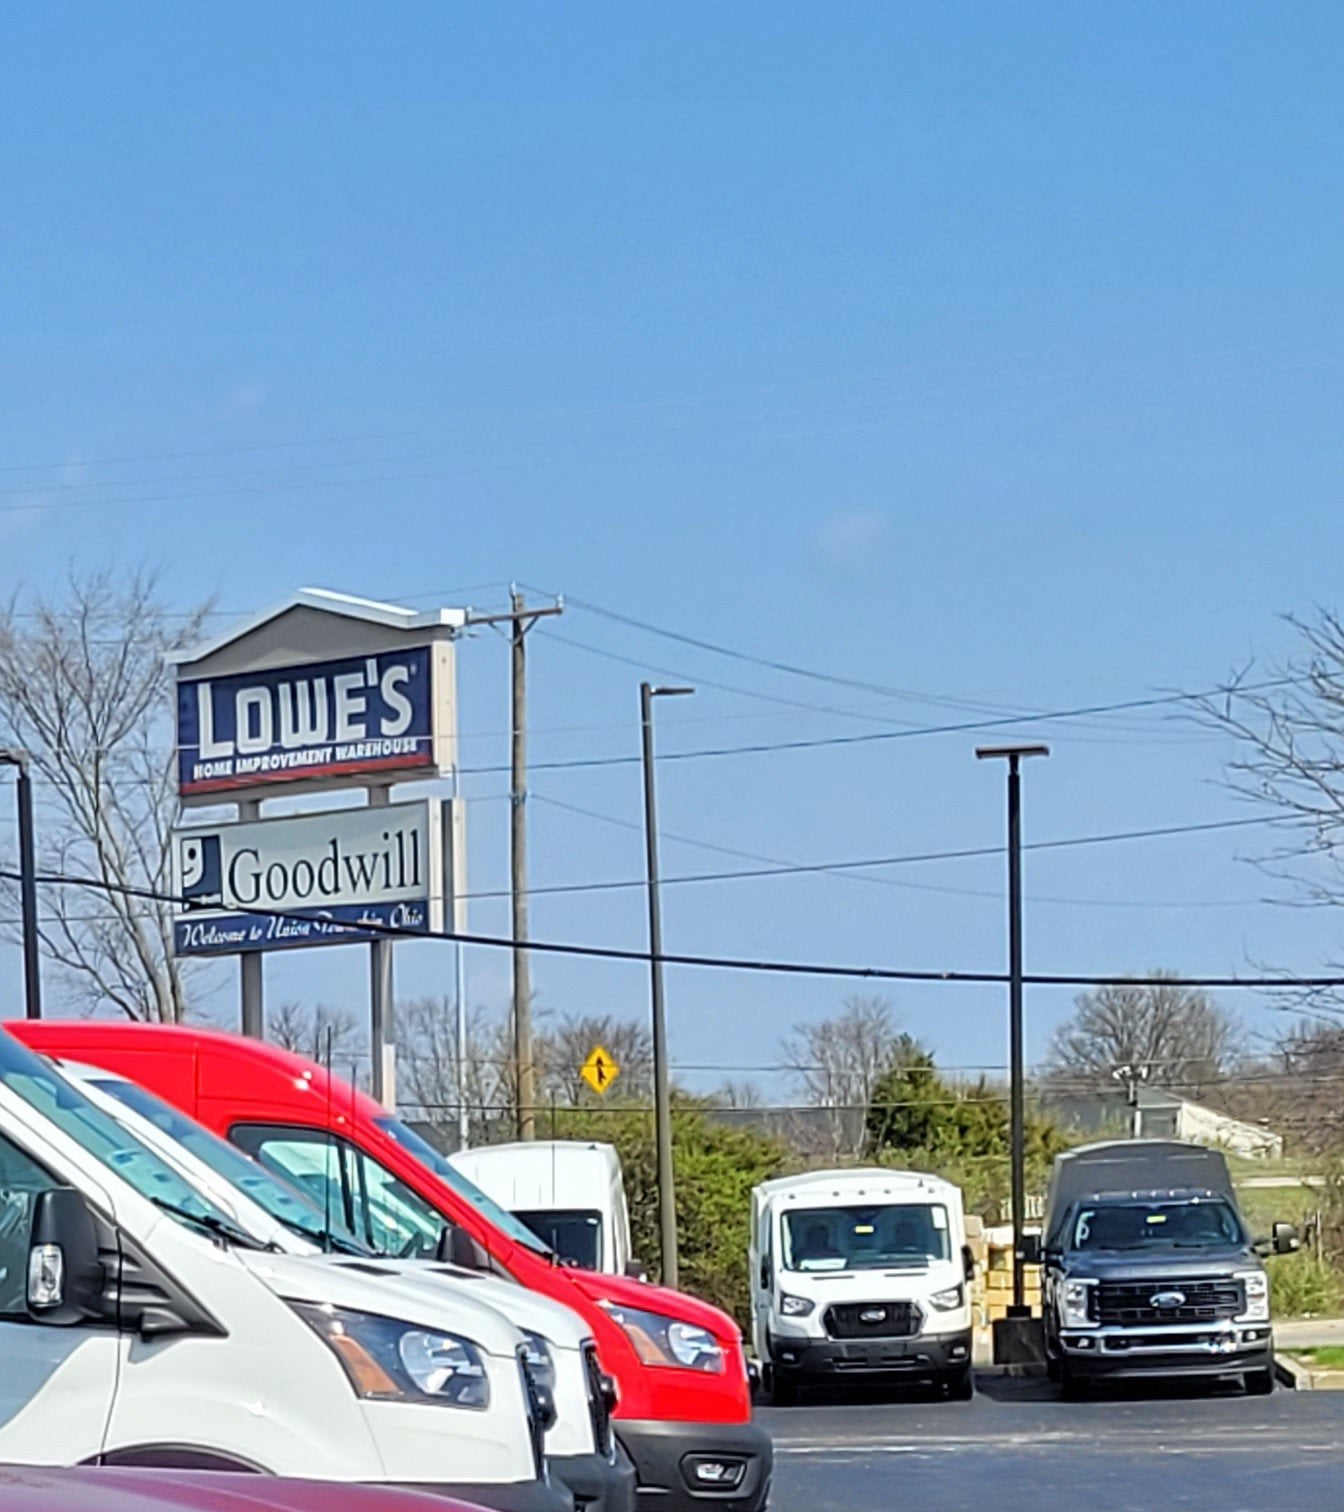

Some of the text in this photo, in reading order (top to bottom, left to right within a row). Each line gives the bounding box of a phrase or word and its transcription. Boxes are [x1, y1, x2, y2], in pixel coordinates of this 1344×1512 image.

[197, 658, 413, 760] LOWE'S
[193, 738, 418, 781] HOME IMPROVEMENT WAREHOUSE
[227, 829, 422, 905] Goodwill
[182, 923, 247, 947] Welcome
[249, 925, 263, 941] to
[266, 915, 311, 939] Union
[389, 903, 424, 928] Ohio
